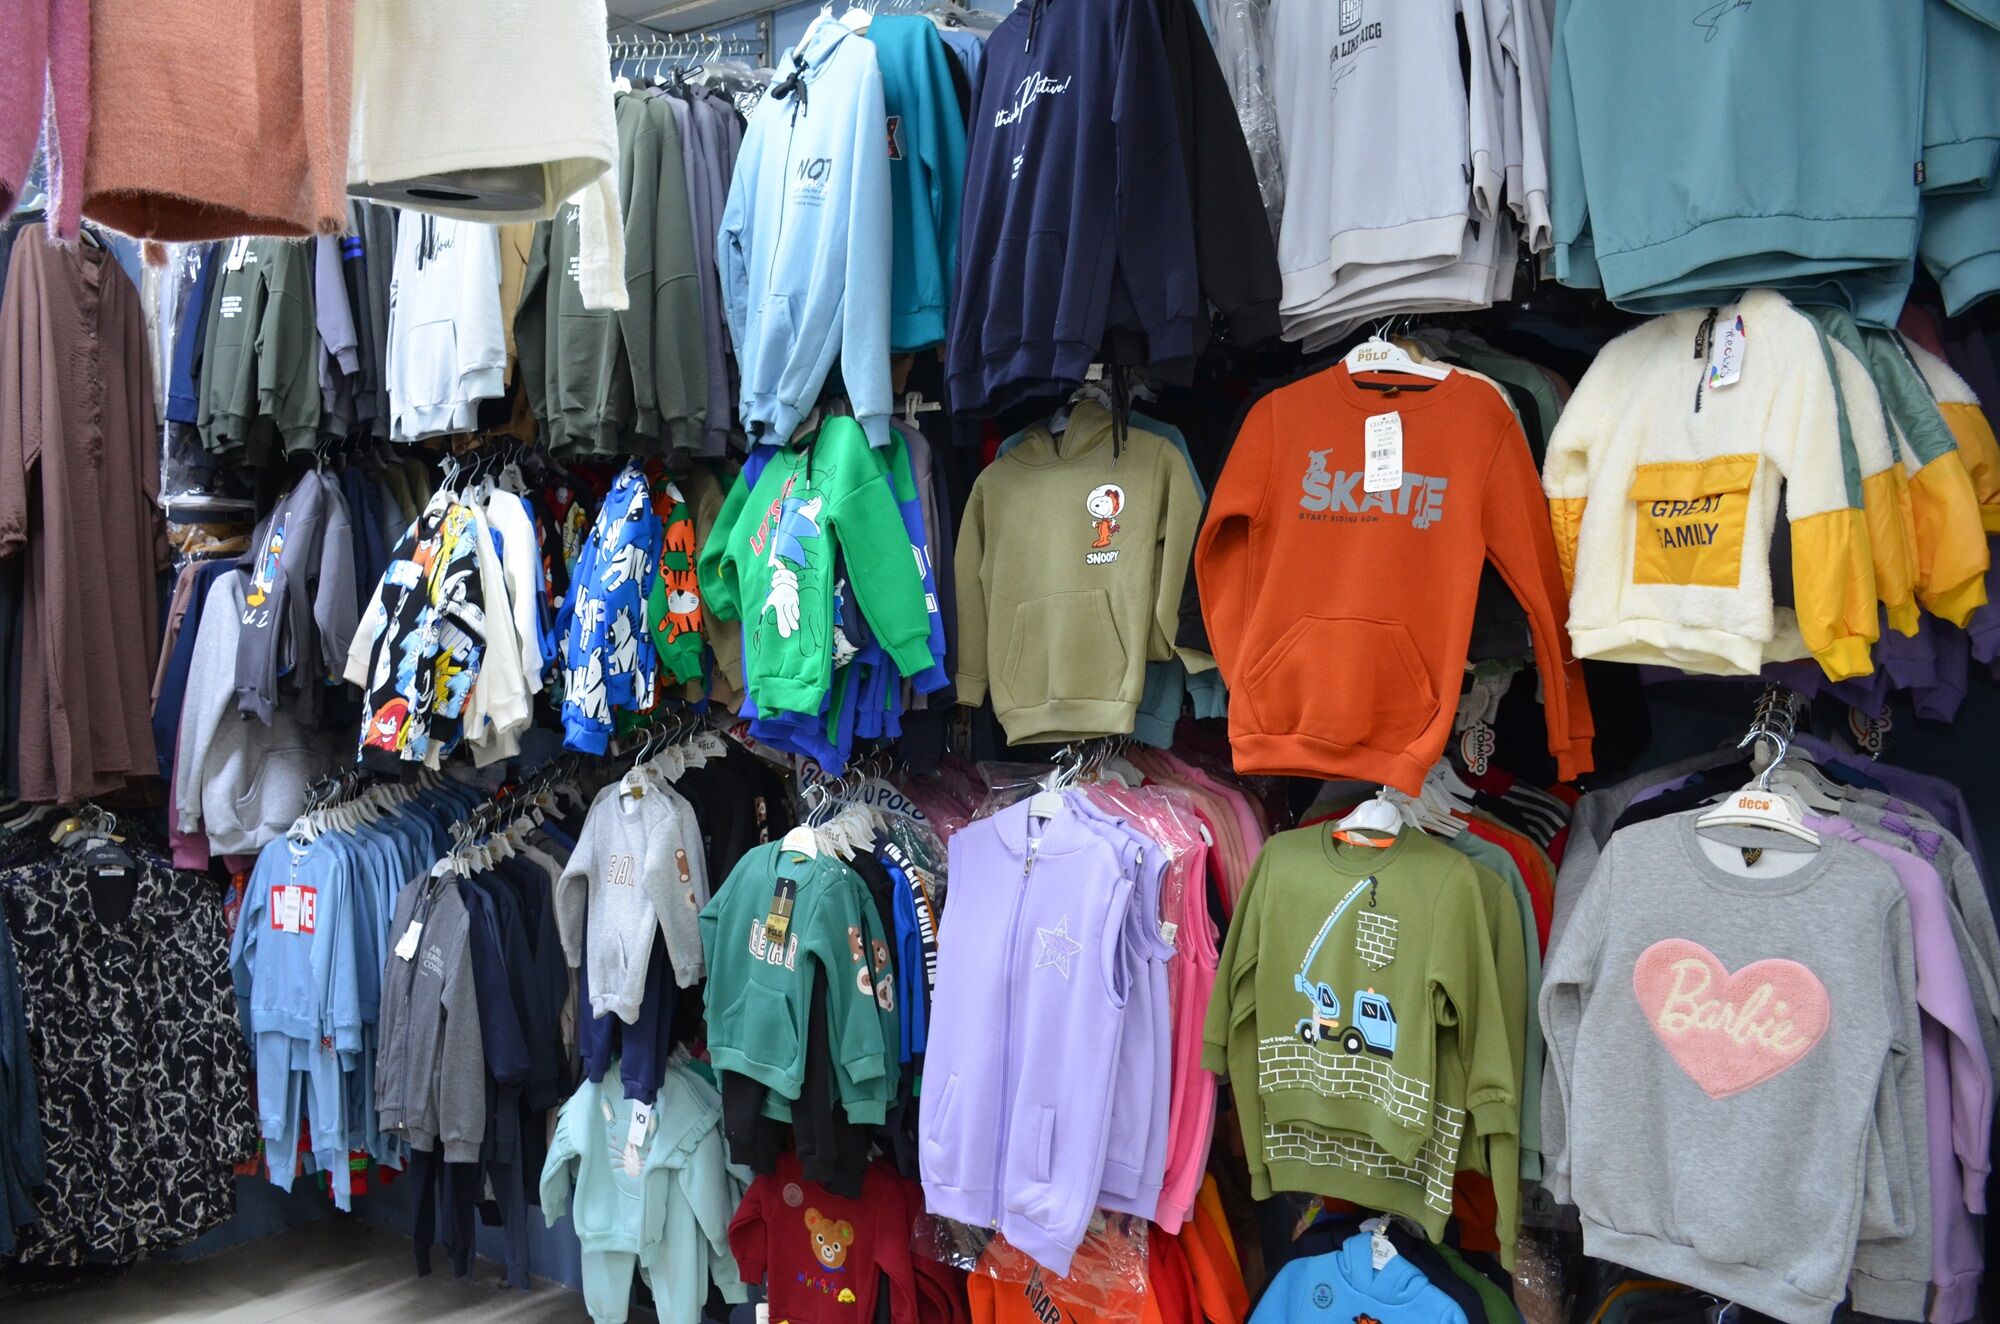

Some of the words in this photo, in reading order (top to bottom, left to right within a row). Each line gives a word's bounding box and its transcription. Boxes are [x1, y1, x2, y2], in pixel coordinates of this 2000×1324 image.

[1357, 352, 1388, 361] POLO
[1299, 470, 1448, 521] SKATE
[1651, 493, 1725, 518] GREAT
[1298, 513, 1328, 522] START
[1086, 550, 1120, 565] SNOOPY
[1868, 718, 1880, 748] MICO
[1476, 726, 1486, 773] TOMICO
[878, 787, 926, 820] POLO
[1738, 797, 1770, 811] deco
[1658, 958, 1809, 1051] Barbie
